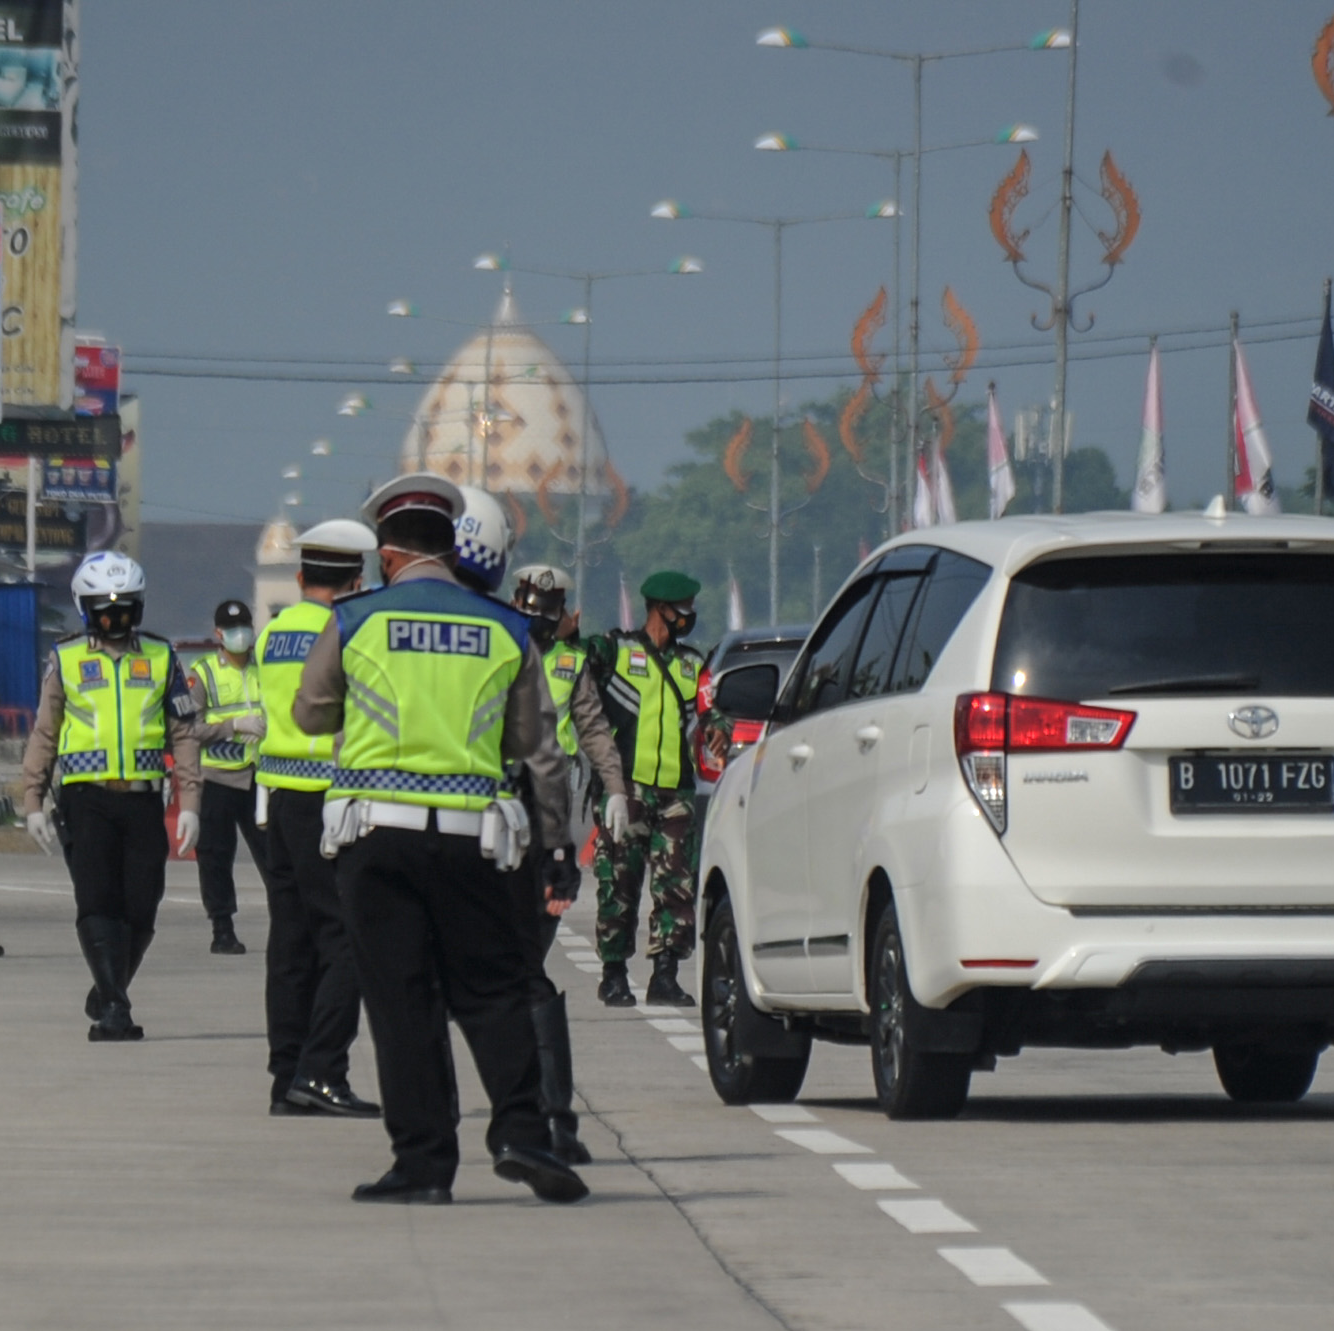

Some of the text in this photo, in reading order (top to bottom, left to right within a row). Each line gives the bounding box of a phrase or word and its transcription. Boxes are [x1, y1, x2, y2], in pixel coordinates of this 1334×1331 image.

[265, 634, 320, 660] POLIS
[389, 619, 488, 656] POLISI
[1180, 762, 1325, 790] B 1071 FZG
